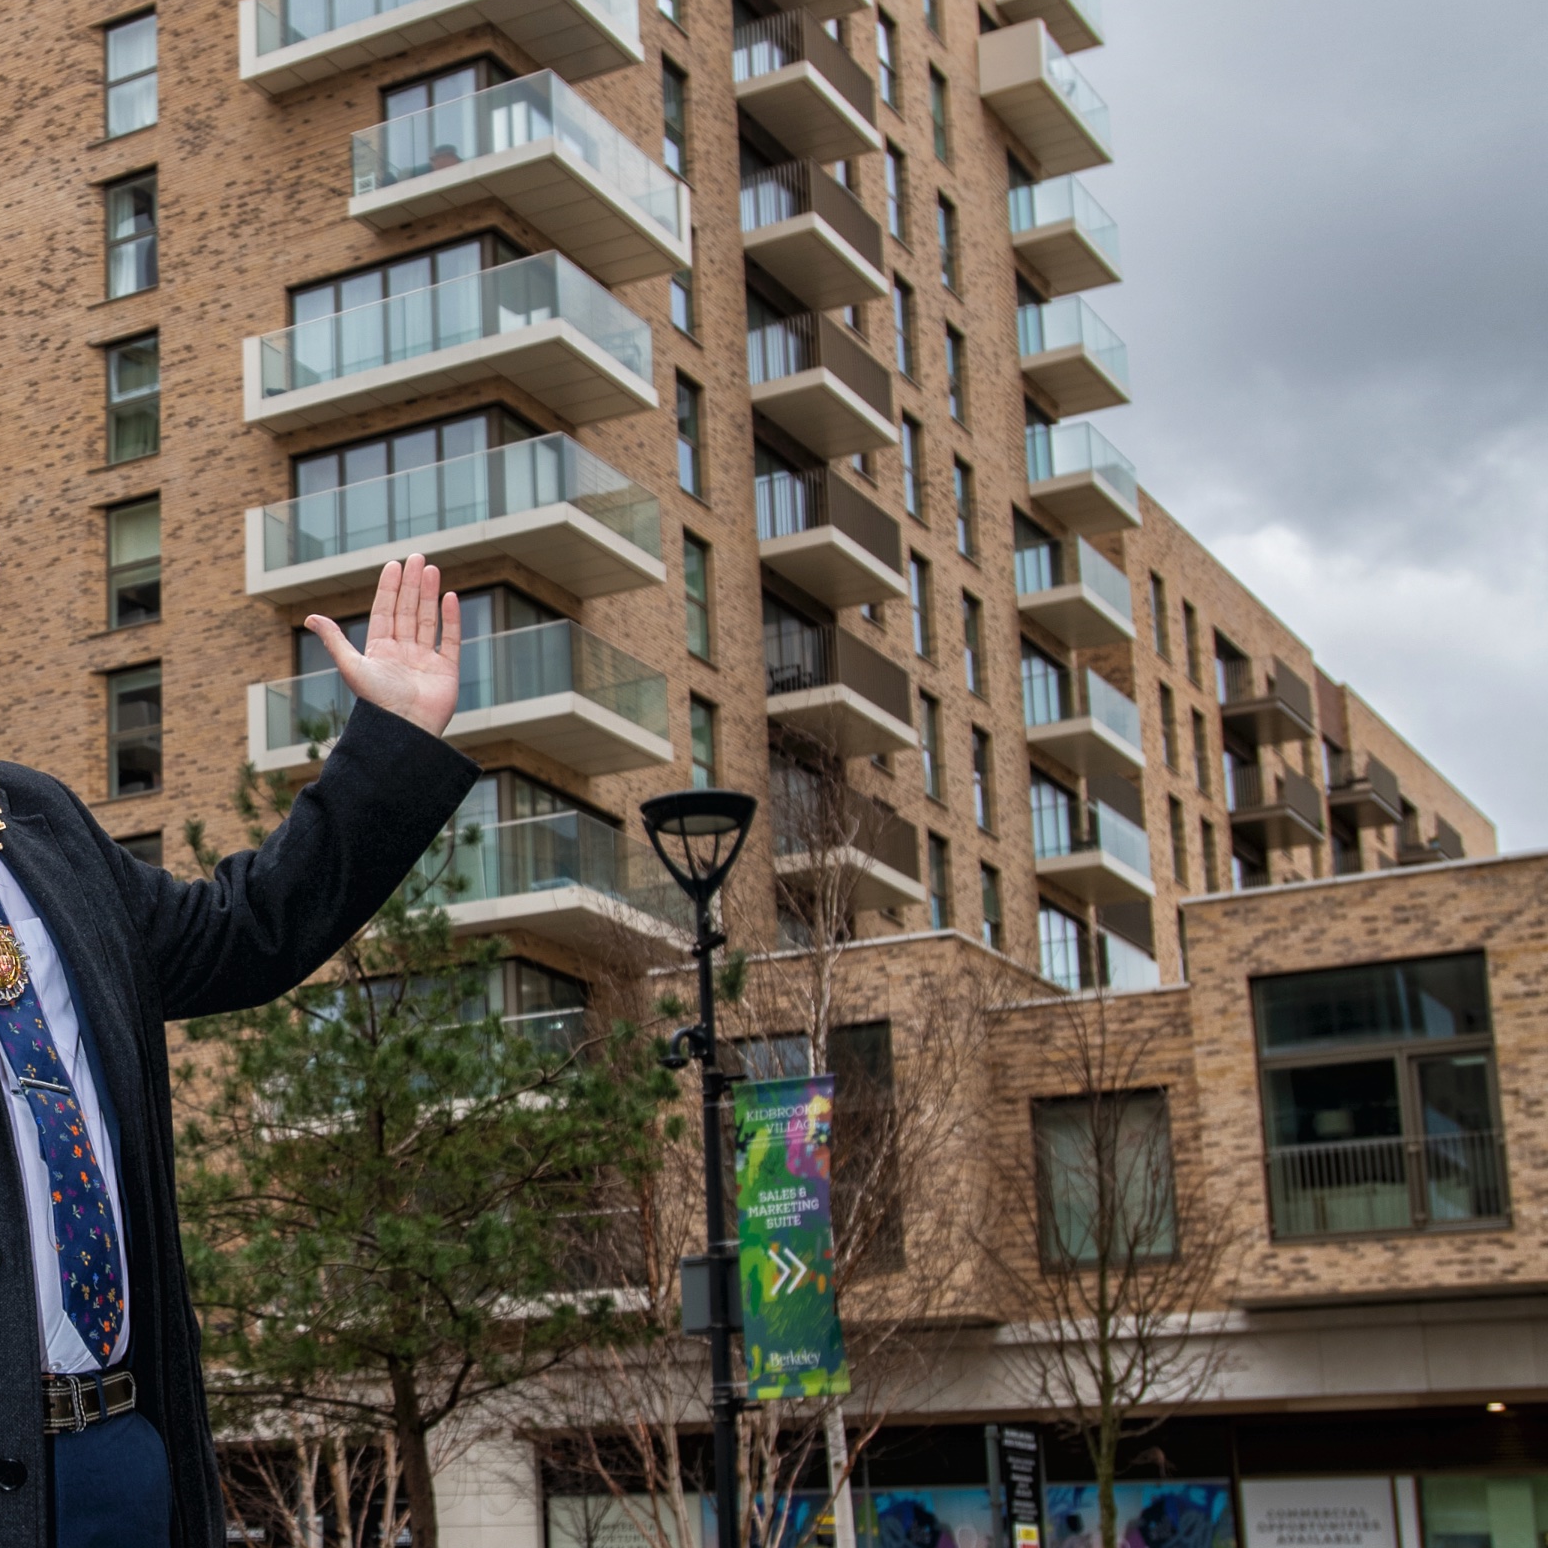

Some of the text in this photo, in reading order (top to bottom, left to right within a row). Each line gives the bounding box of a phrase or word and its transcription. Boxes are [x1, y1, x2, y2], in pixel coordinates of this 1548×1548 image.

[746, 1103, 821, 1122] KIDBROOKE
[766, 1119, 820, 1134] VILLAGE
[758, 1187, 807, 1203] SALES &
[748, 1199, 820, 1218] MARKETING
[765, 1215, 802, 1230] SUITE
[770, 1349, 821, 1369] Berkeley
